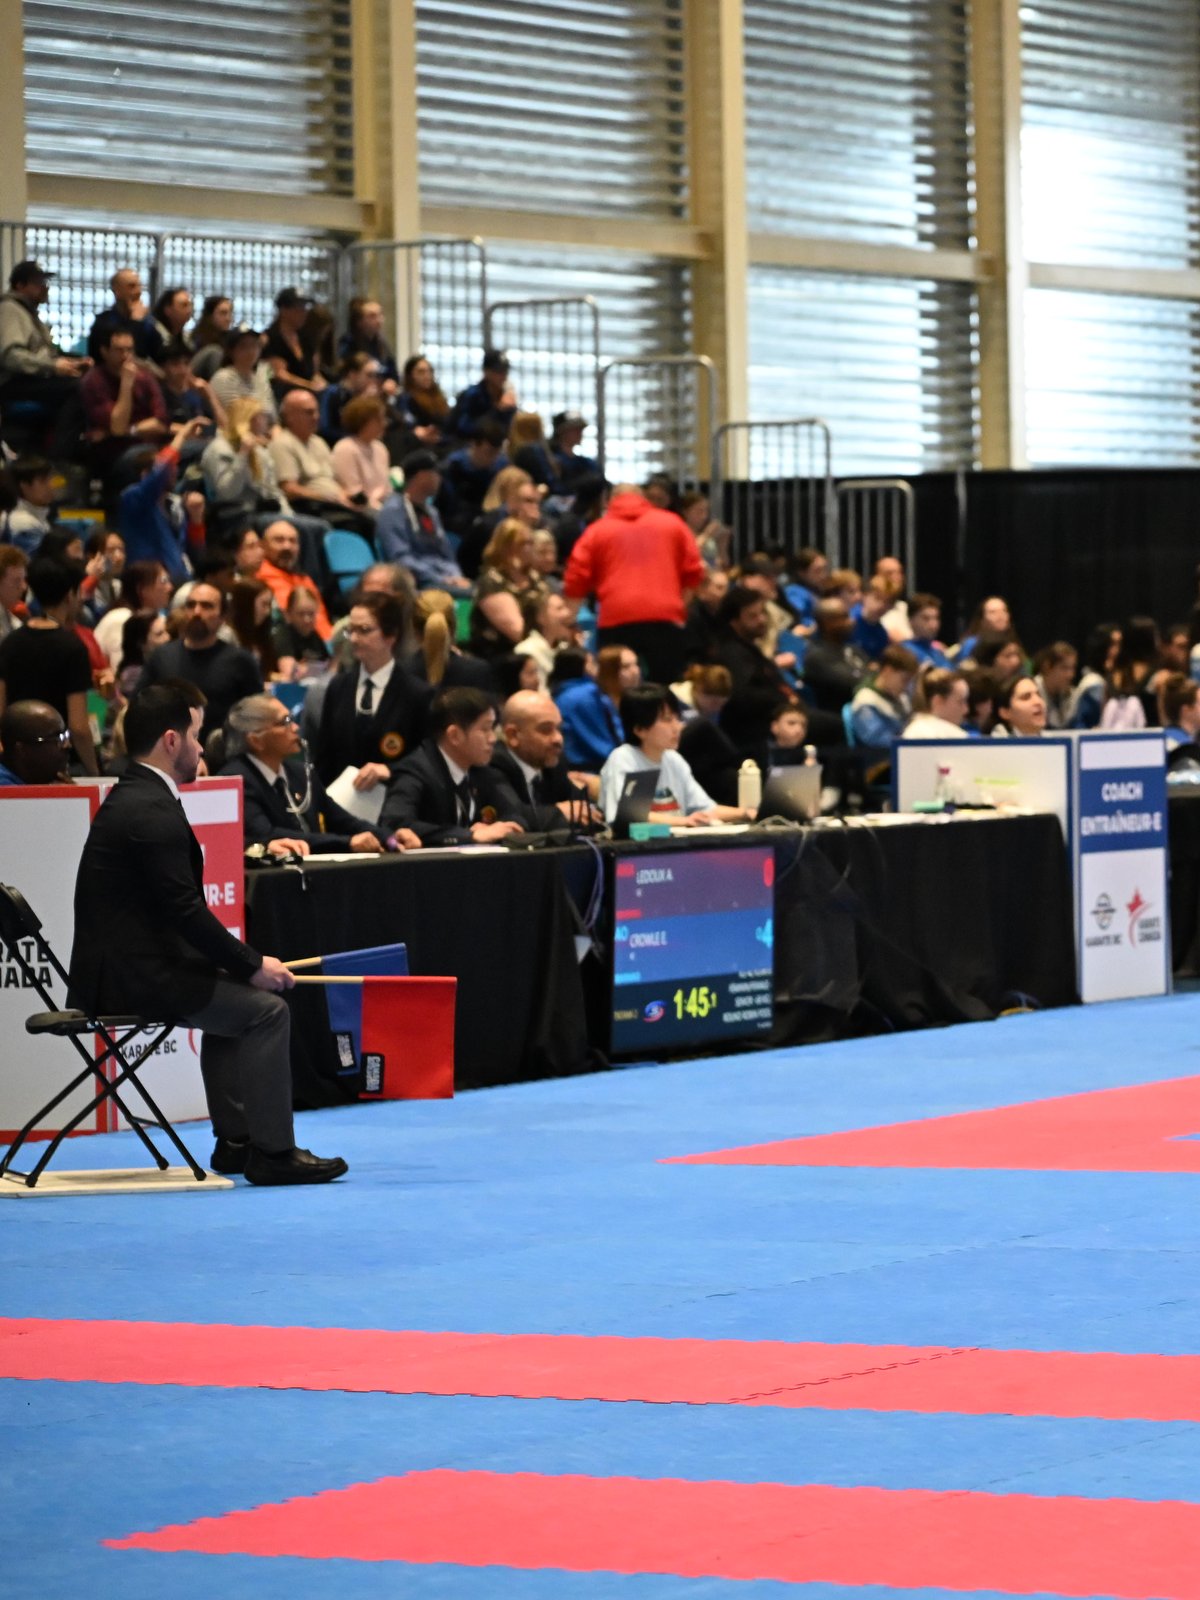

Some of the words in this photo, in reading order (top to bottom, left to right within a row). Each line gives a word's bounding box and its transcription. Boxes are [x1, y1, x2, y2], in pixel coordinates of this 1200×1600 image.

[1101, 781, 1144, 802] COACH
[0, 966, 53, 989] ADA
[163, 1040, 178, 1055] BC
